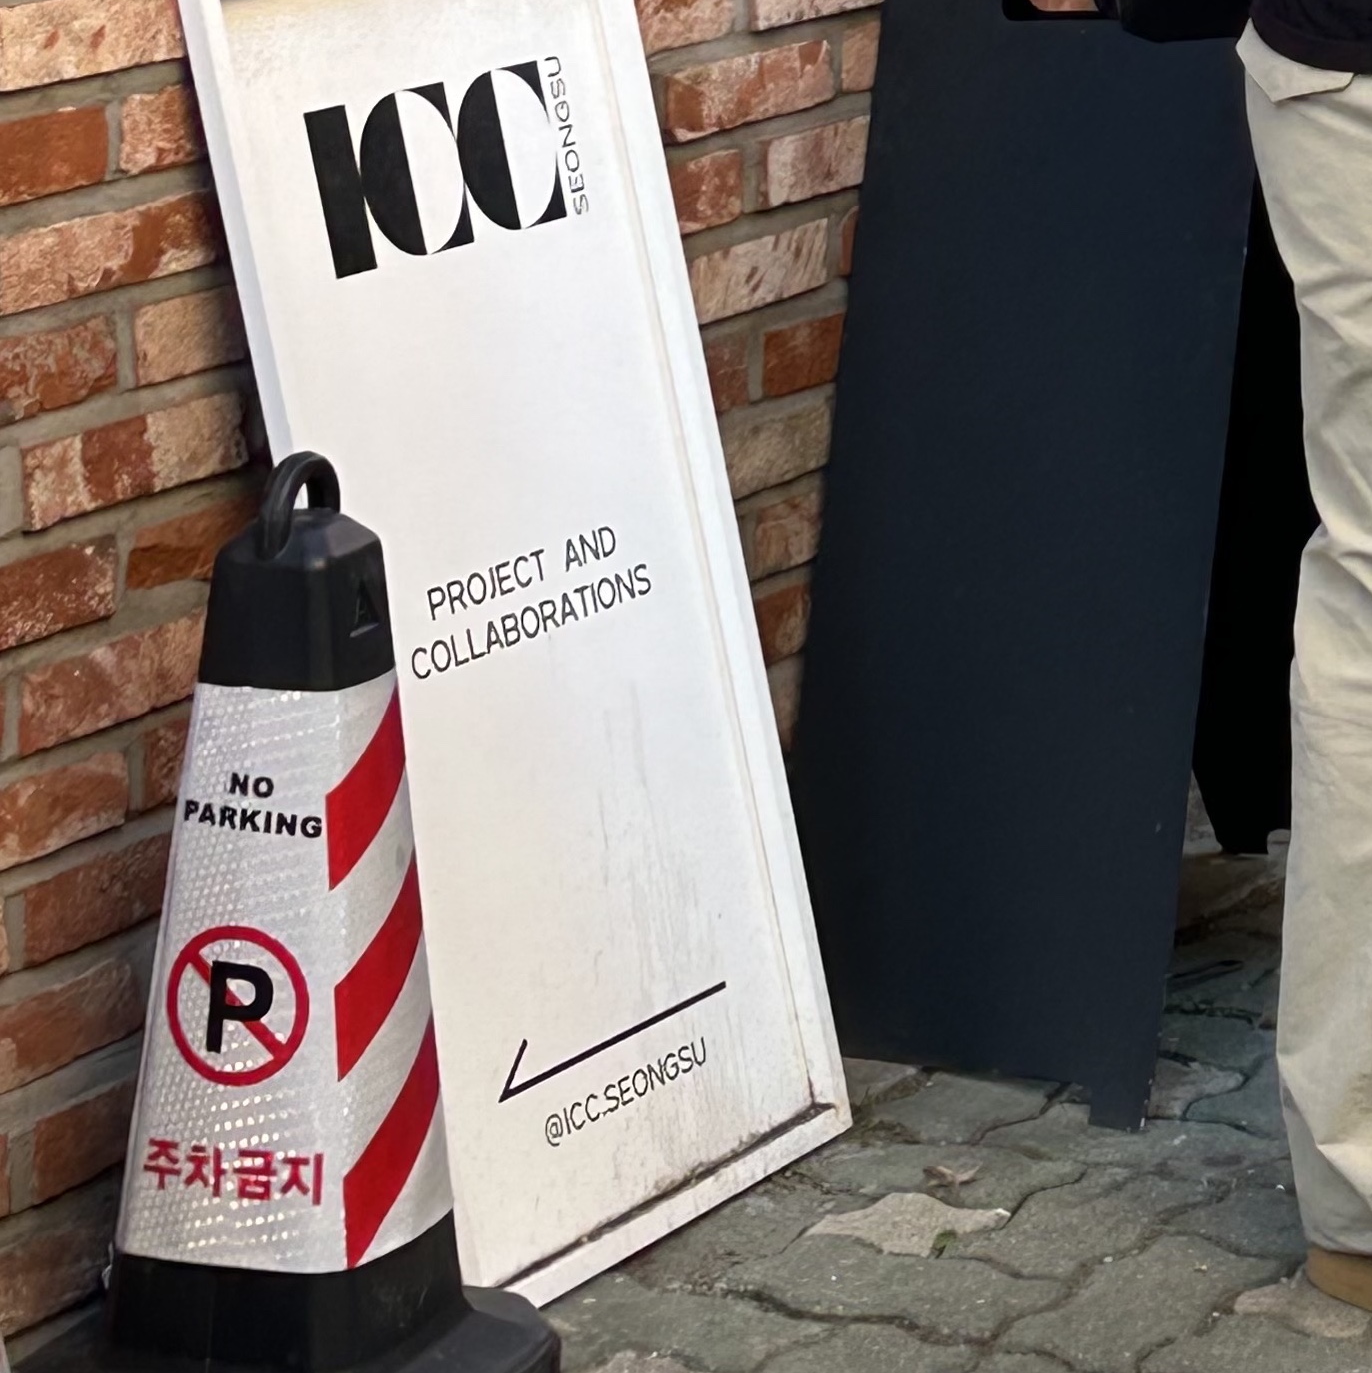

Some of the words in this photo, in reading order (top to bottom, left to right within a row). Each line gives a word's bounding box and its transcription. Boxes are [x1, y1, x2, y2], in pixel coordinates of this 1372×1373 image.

[303, 60, 568, 280] ICC
[544, 55, 590, 216] SEONGSU
[427, 548, 545, 621] PROJECT
[565, 526, 616, 572] AND
[411, 563, 652, 680] COLLABORATIONS
[183, 799, 323, 839] PARKING
[229, 772, 275, 799] NO
[205, 960, 274, 1054] P
[142, 1136, 325, 1207] 주차금지
